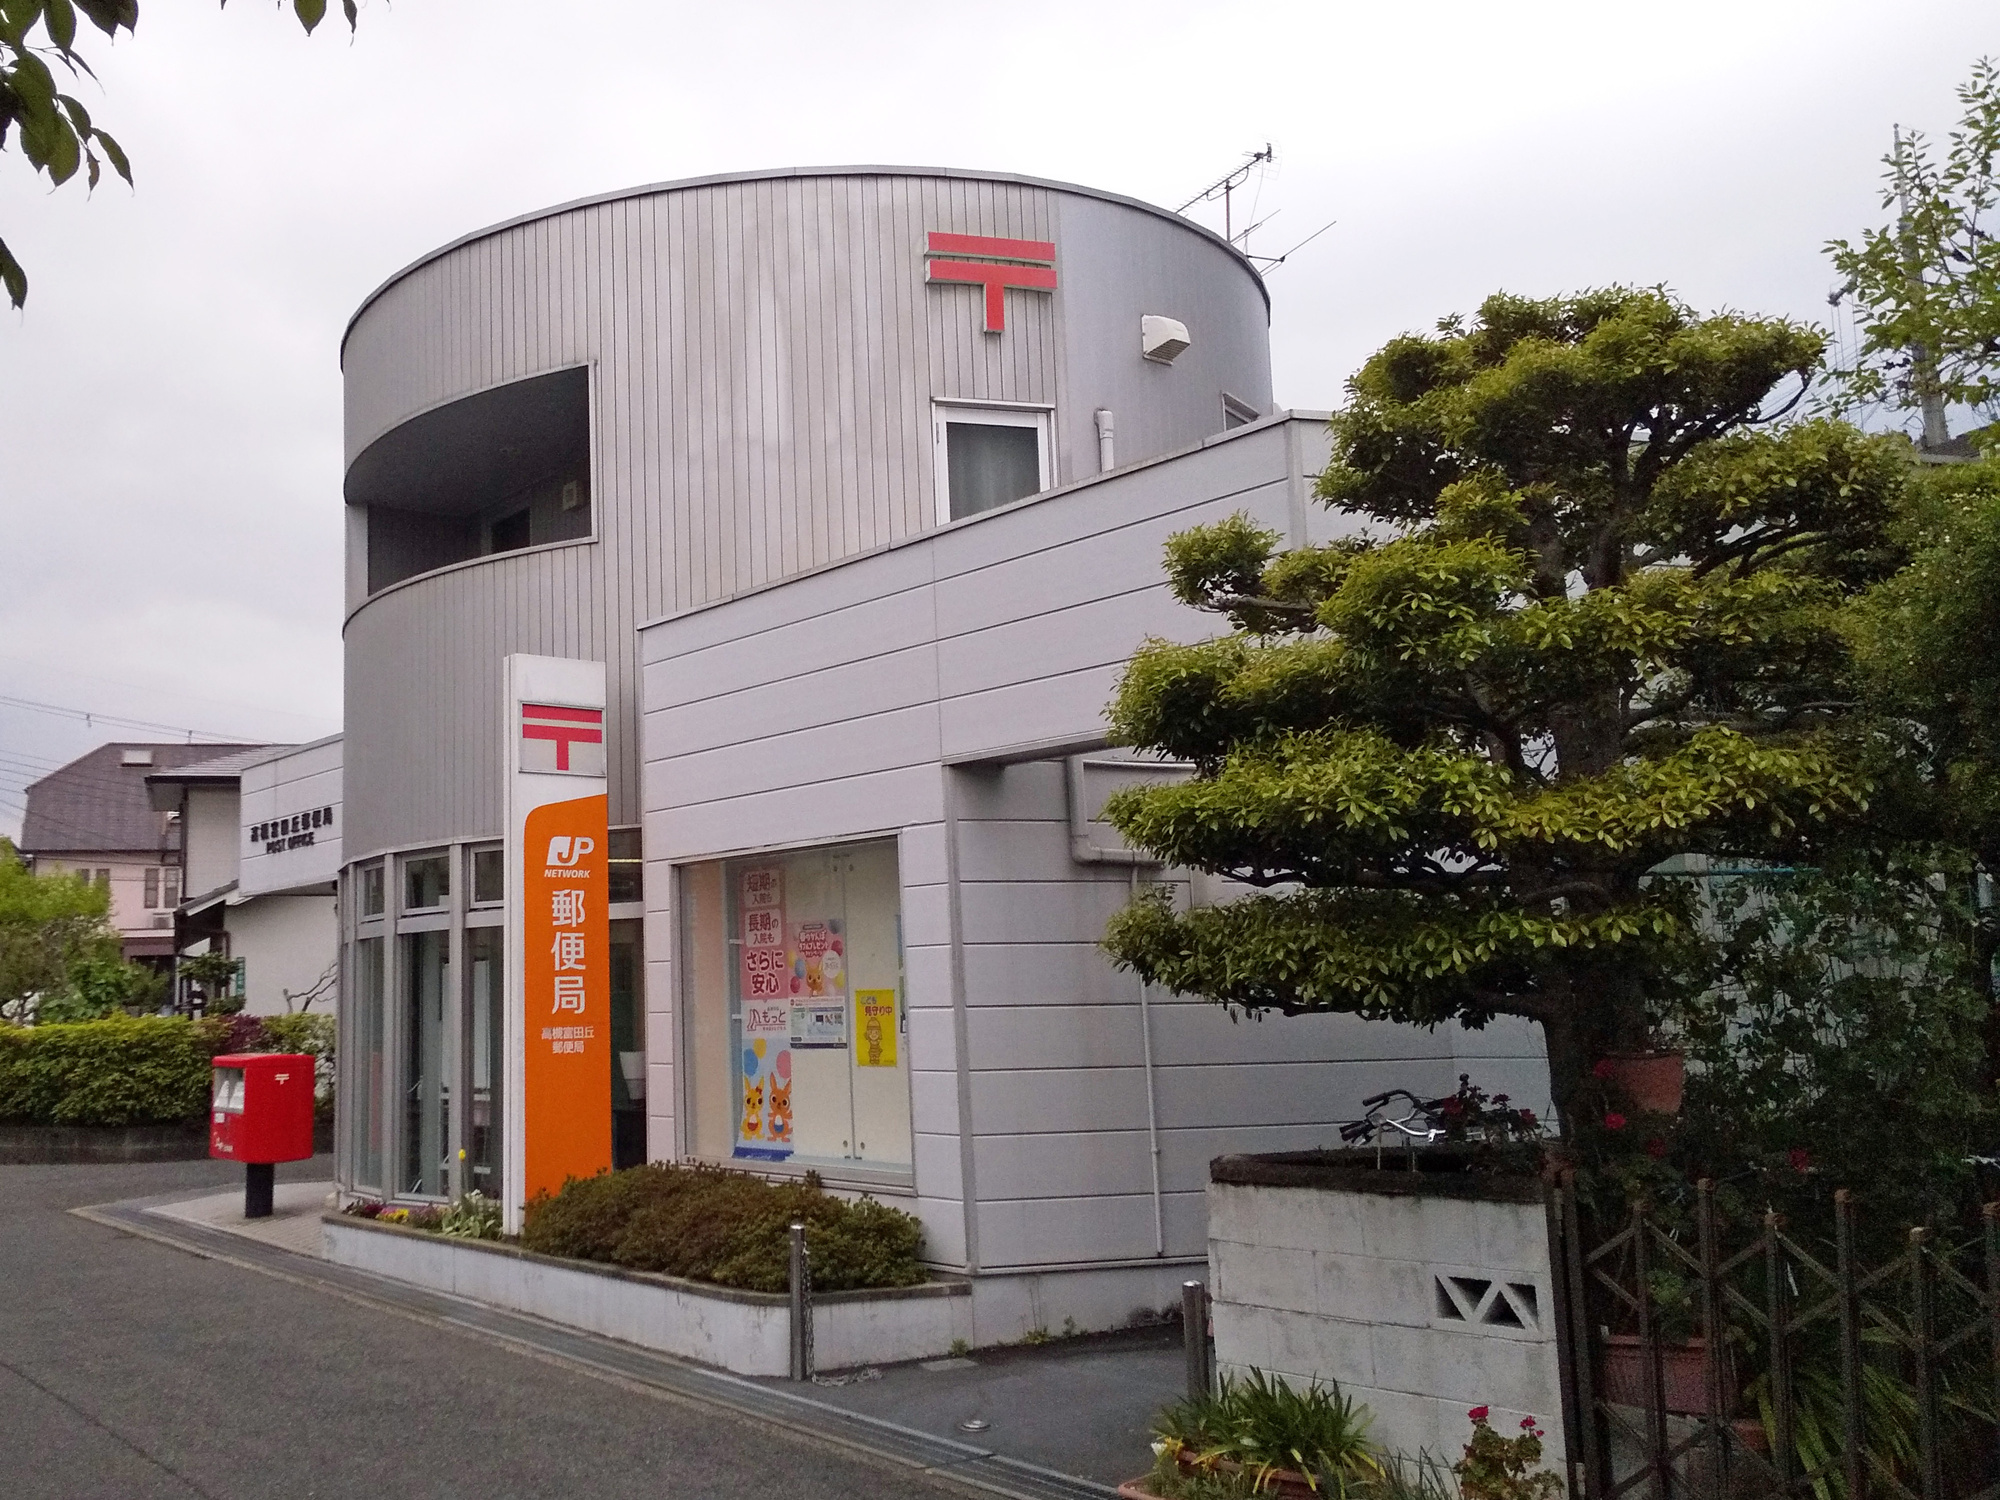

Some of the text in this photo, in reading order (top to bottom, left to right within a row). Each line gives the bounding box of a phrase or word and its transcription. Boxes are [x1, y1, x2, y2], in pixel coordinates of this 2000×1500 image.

[266, 832, 315, 854] POST OFFICE
[544, 869, 591, 879] NETWORK
[748, 912, 779, 931] 長期の
[753, 932, 775, 945] 入院も
[550, 889, 587, 1015] 郵便局
[746, 950, 784, 971] さらに
[752, 972, 780, 994] 安心
[762, 1008, 786, 1023] もっと
[864, 1005, 893, 1016] 見守り中
[541, 1026, 595, 1041] 高槻富田丘
[552, 1040, 585, 1054] 郵便局
